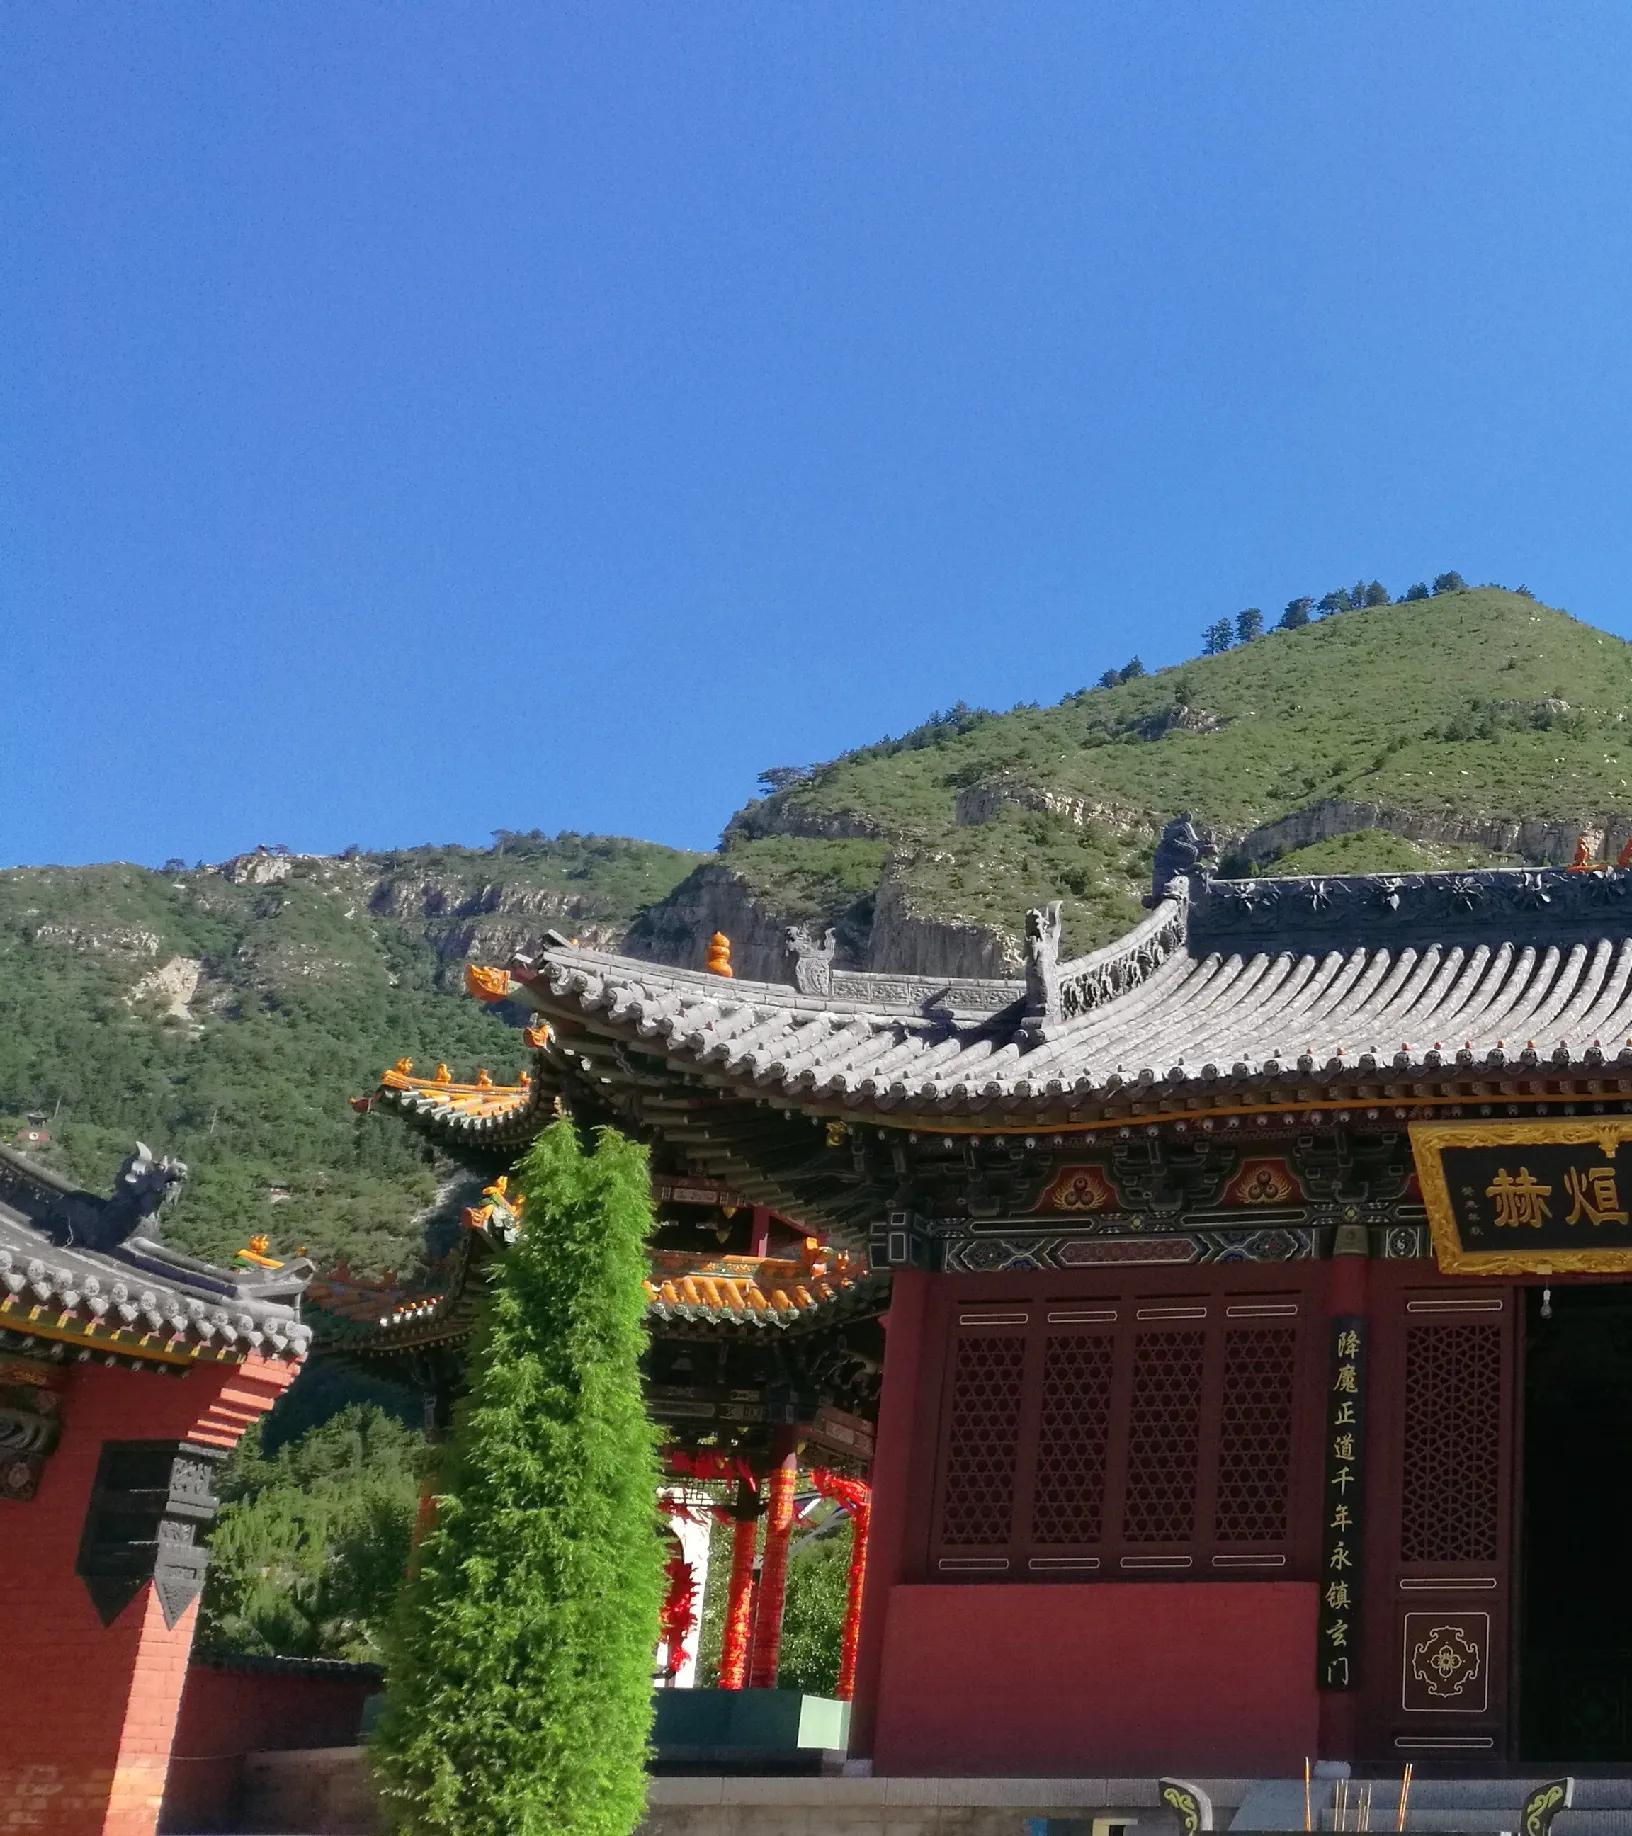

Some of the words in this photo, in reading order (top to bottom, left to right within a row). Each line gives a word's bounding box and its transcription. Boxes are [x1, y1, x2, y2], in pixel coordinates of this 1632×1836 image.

[1325, 1330, 1362, 1686] 降魔正道千年永镇玄门
